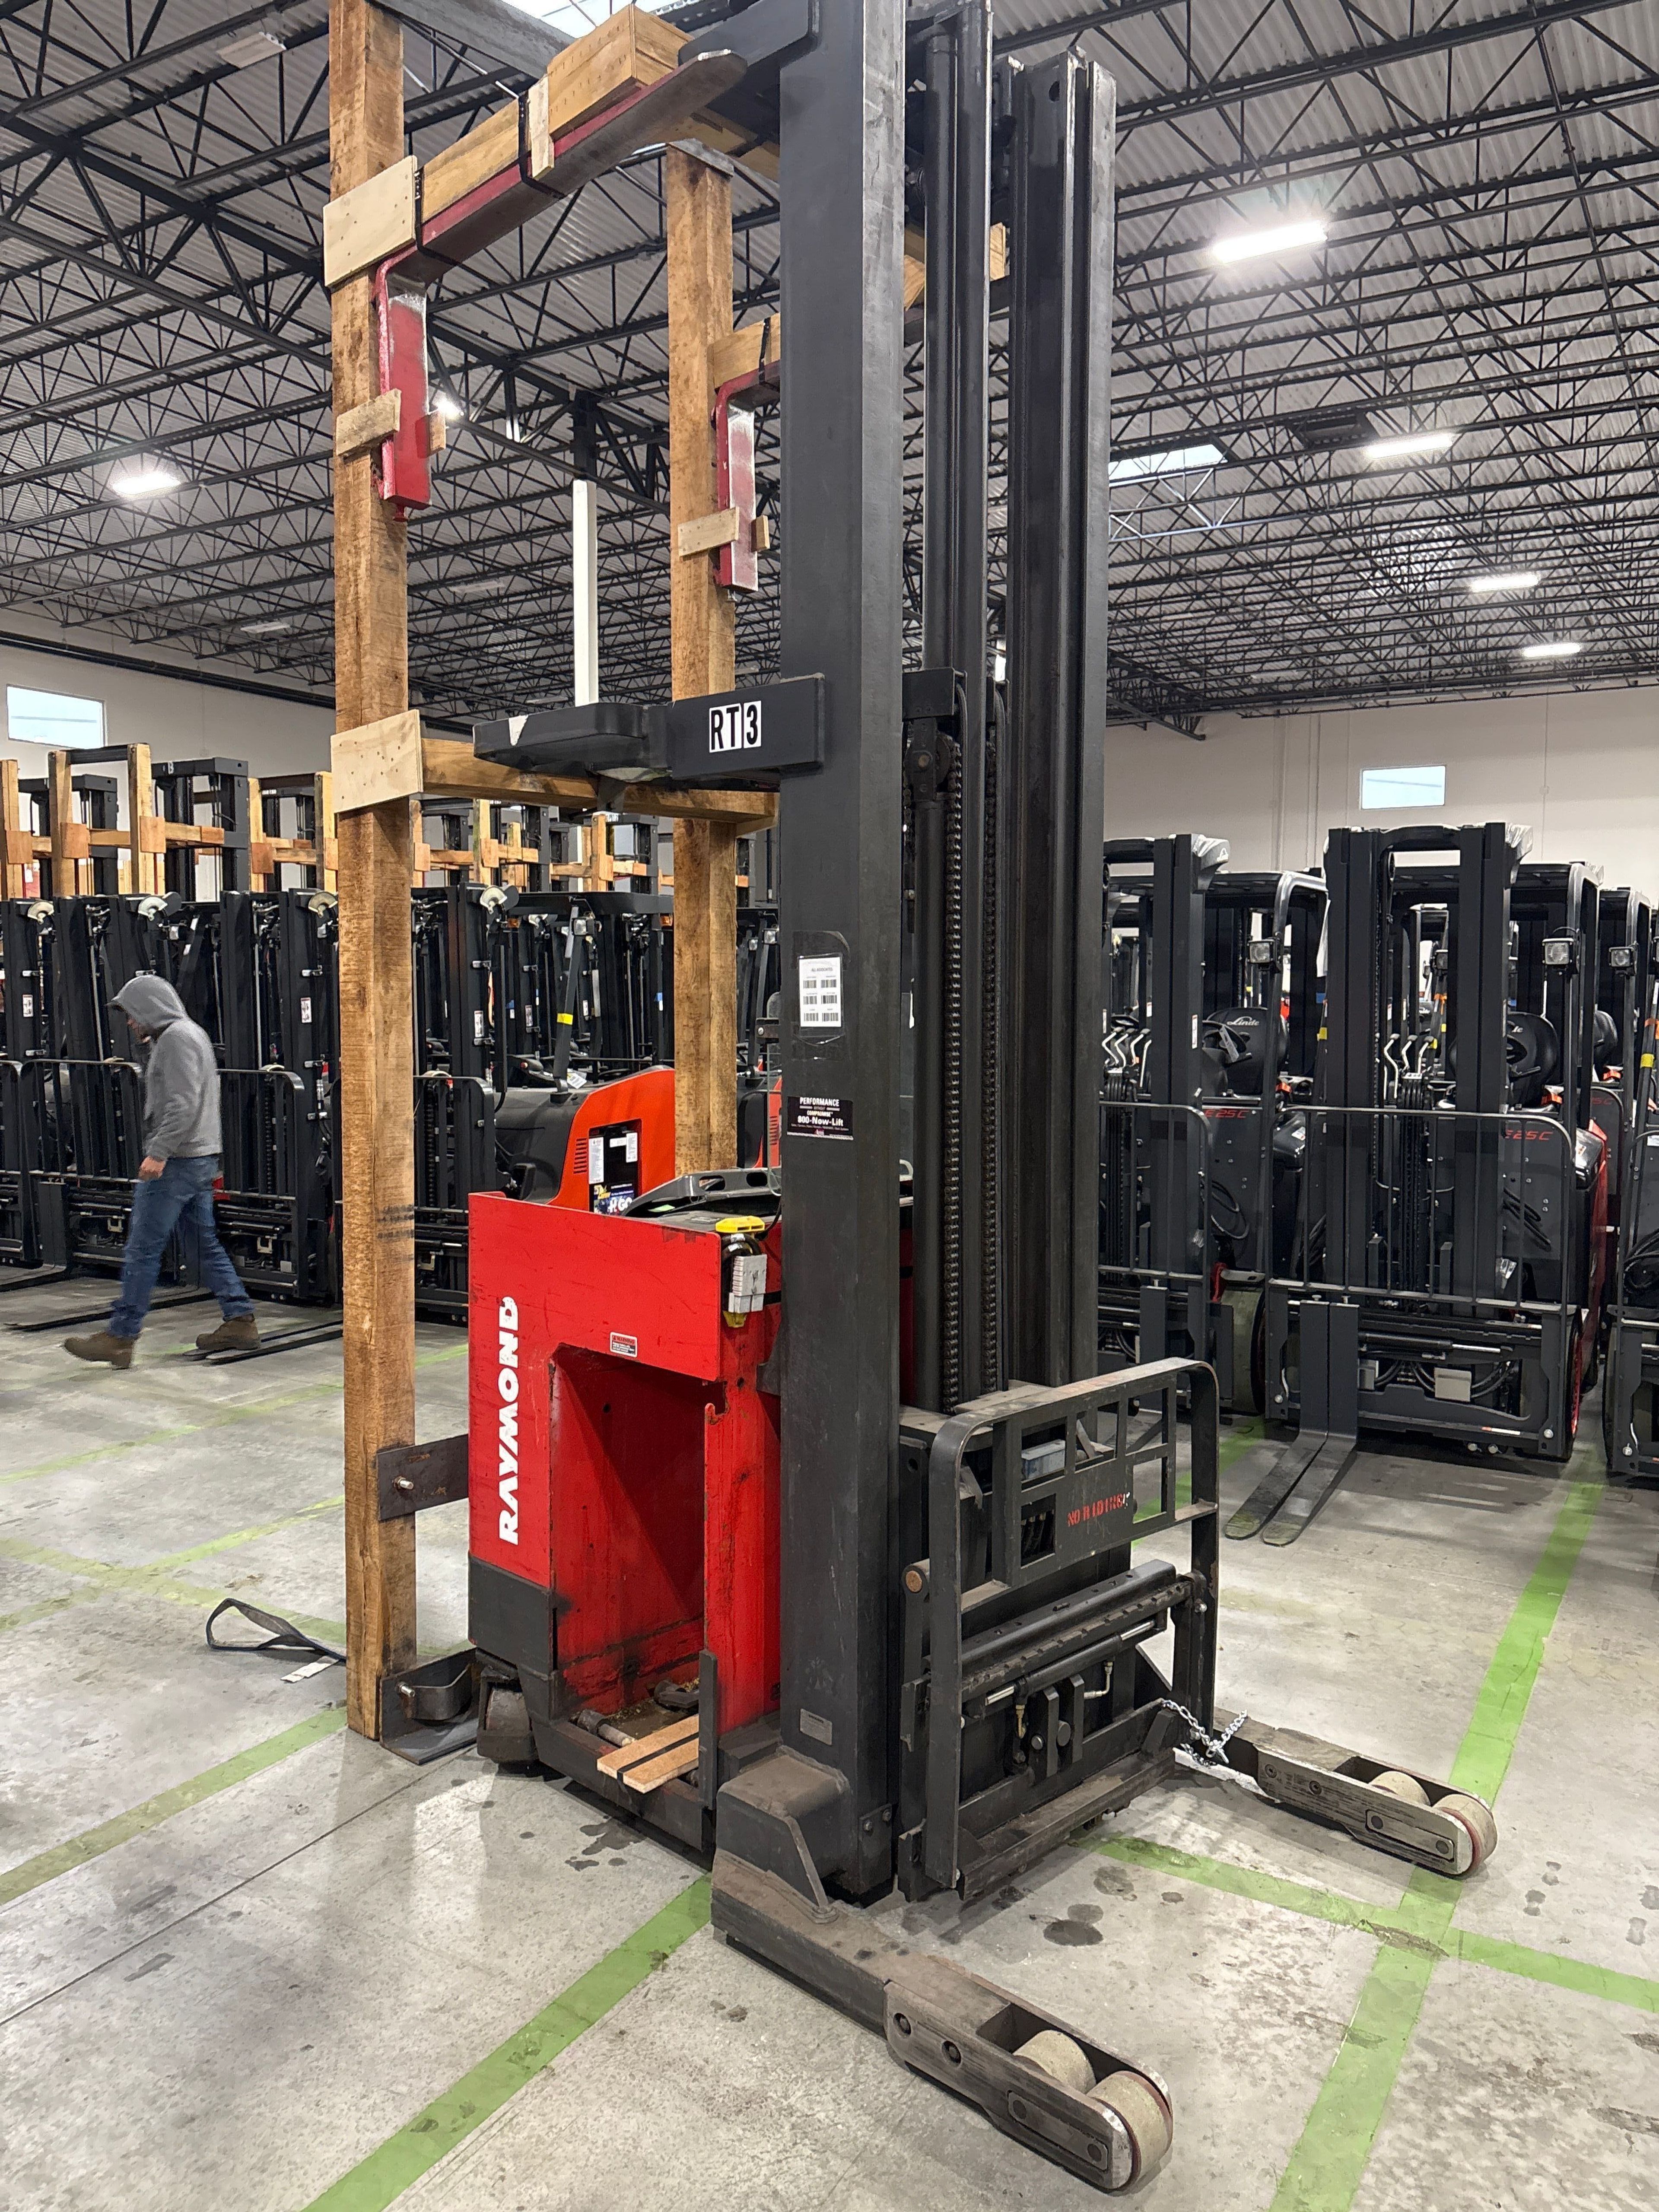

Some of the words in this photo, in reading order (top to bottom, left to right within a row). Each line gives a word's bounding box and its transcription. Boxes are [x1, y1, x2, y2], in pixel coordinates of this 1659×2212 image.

[1226, 1016, 1259, 1026] Linde
[800, 1096, 840, 1106] PERFORMANCE
[798, 1116, 843, 1126] 800-Now-Lift
[498, 1296, 519, 1545] RAYMOND
[1067, 1508, 1081, 1527] NO
